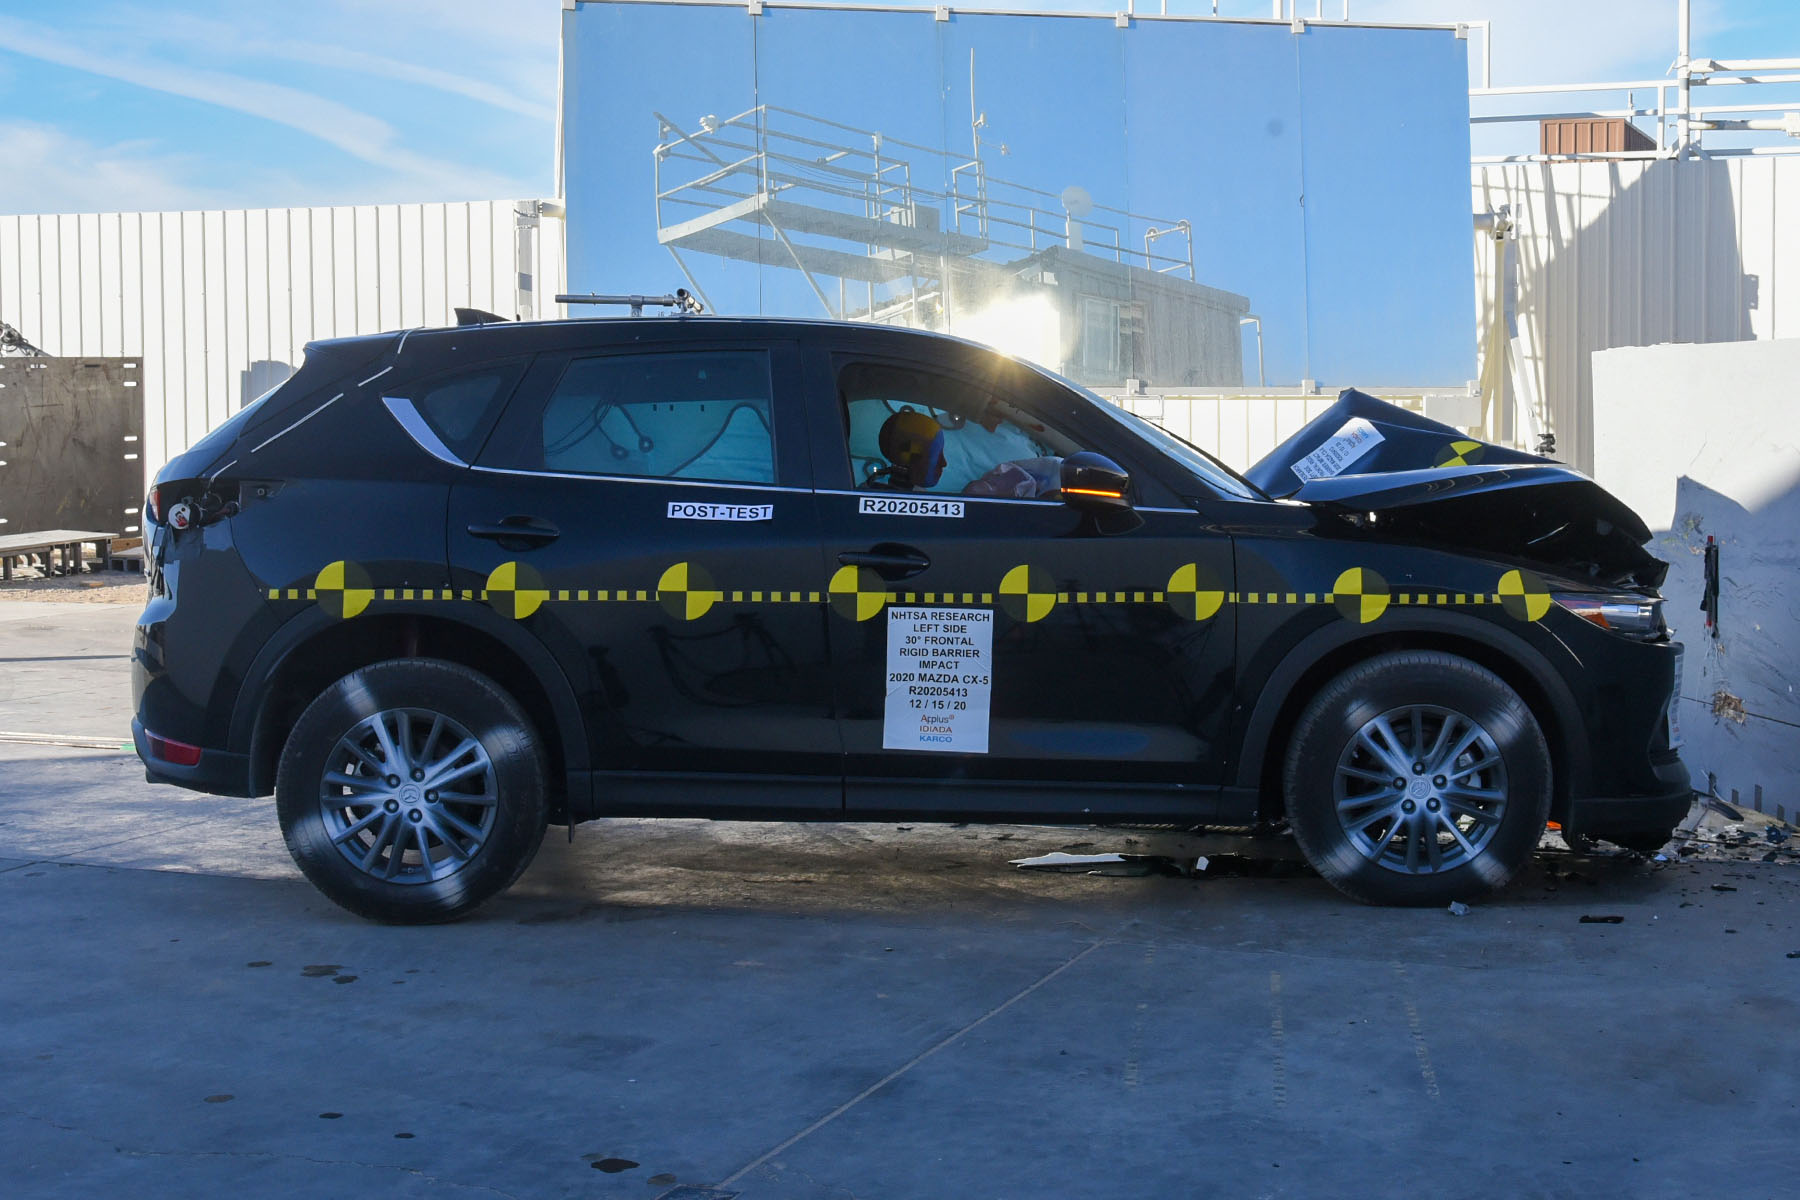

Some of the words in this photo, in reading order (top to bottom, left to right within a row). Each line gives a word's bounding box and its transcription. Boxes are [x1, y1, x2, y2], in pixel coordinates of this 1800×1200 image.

[671, 504, 772, 519] POST-TEST
[863, 499, 961, 516] R20205413
[891, 611, 928, 621] NHTSA
[931, 612, 990, 622] RESEARCH
[913, 624, 940, 633] LEFT
[943, 625, 967, 634] SIDE
[924, 636, 974, 646] FRONTAL
[899, 648, 929, 657] RIGID
[932, 649, 980, 658] BARRIER
[919, 661, 960, 670] IMPACT
[889, 673, 915, 682] 2020
[918, 674, 960, 684] MAZDA
[962, 675, 989, 685] CX-5
[909, 686, 968, 697] R20205413
[909, 699, 922, 709] 12
[932, 700, 945, 710] 15
[953, 701, 967, 711] 20
[919, 725, 953, 733] IDIADA
[919, 735, 953, 743] KARCO
